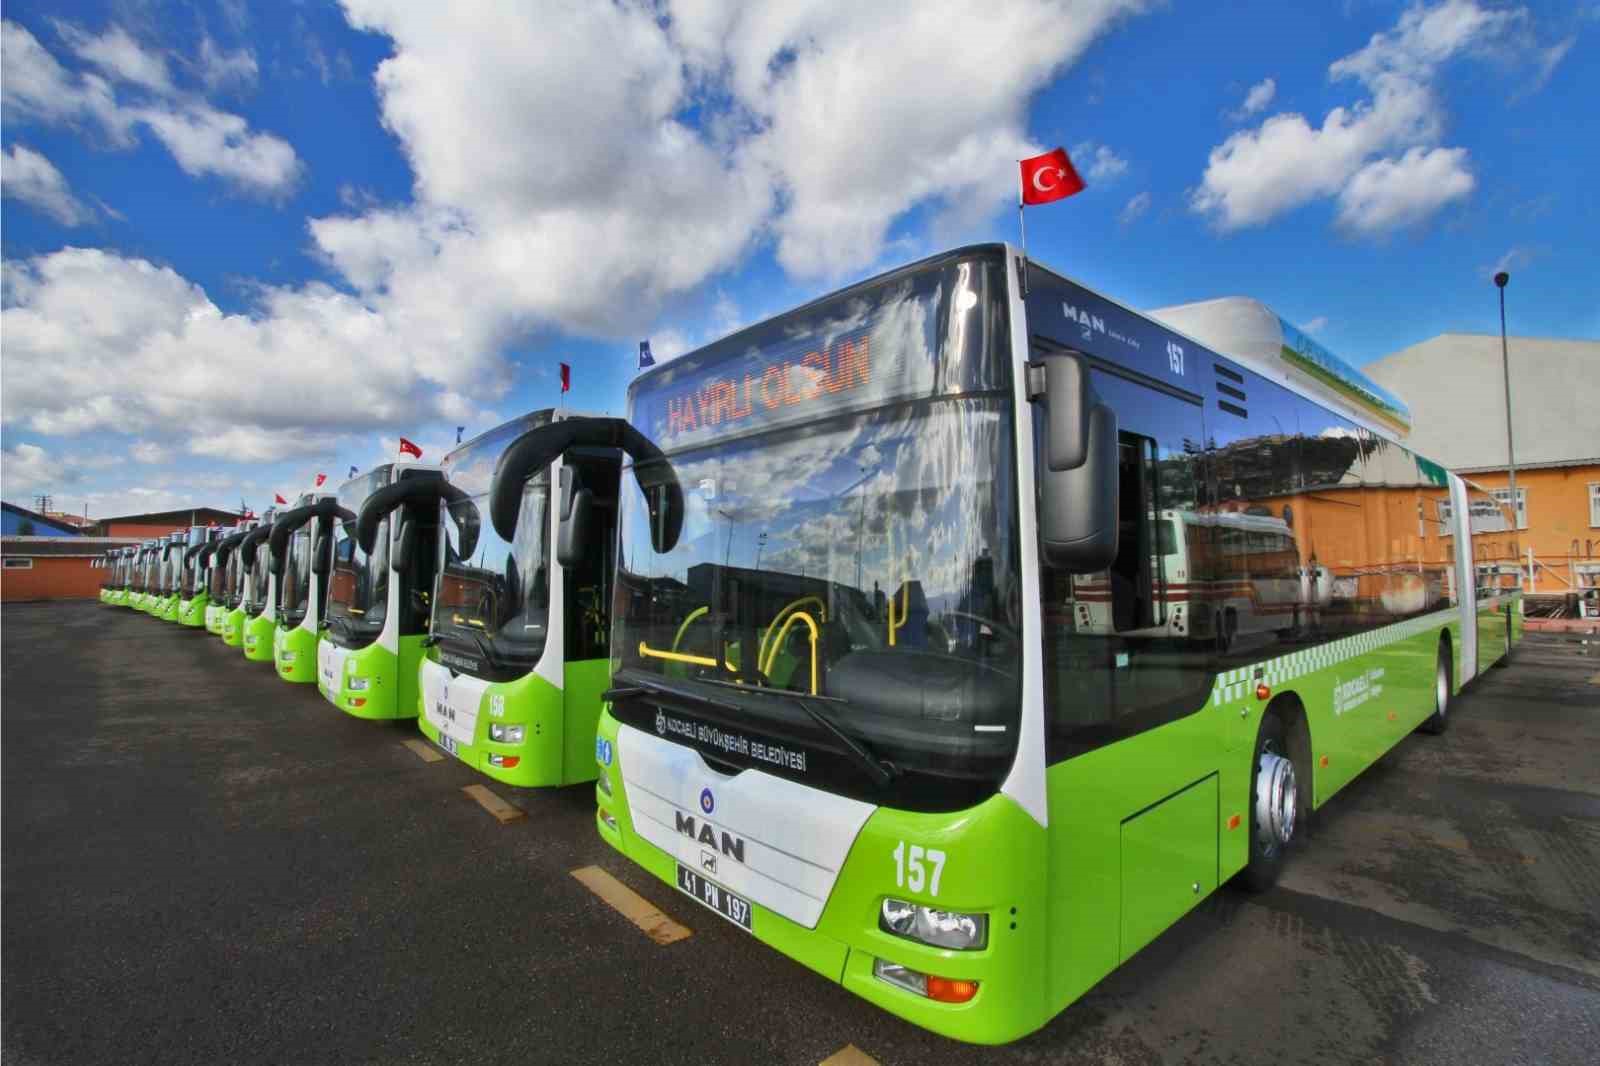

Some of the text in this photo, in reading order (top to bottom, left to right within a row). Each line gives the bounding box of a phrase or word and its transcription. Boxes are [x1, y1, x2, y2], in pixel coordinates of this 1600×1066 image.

[1063, 302, 1105, 334] MAN
[761, 335, 871, 410] OLSUN
[1166, 340, 1185, 376] 157
[436, 701, 456, 723] MAN
[666, 718, 807, 772] KOCAELİ BÜYÜKŞEHİR BELEDİYESİ
[675, 810, 745, 863] MAN
[893, 840, 946, 896] 157
[683, 870, 748, 923] 41 PN 197
